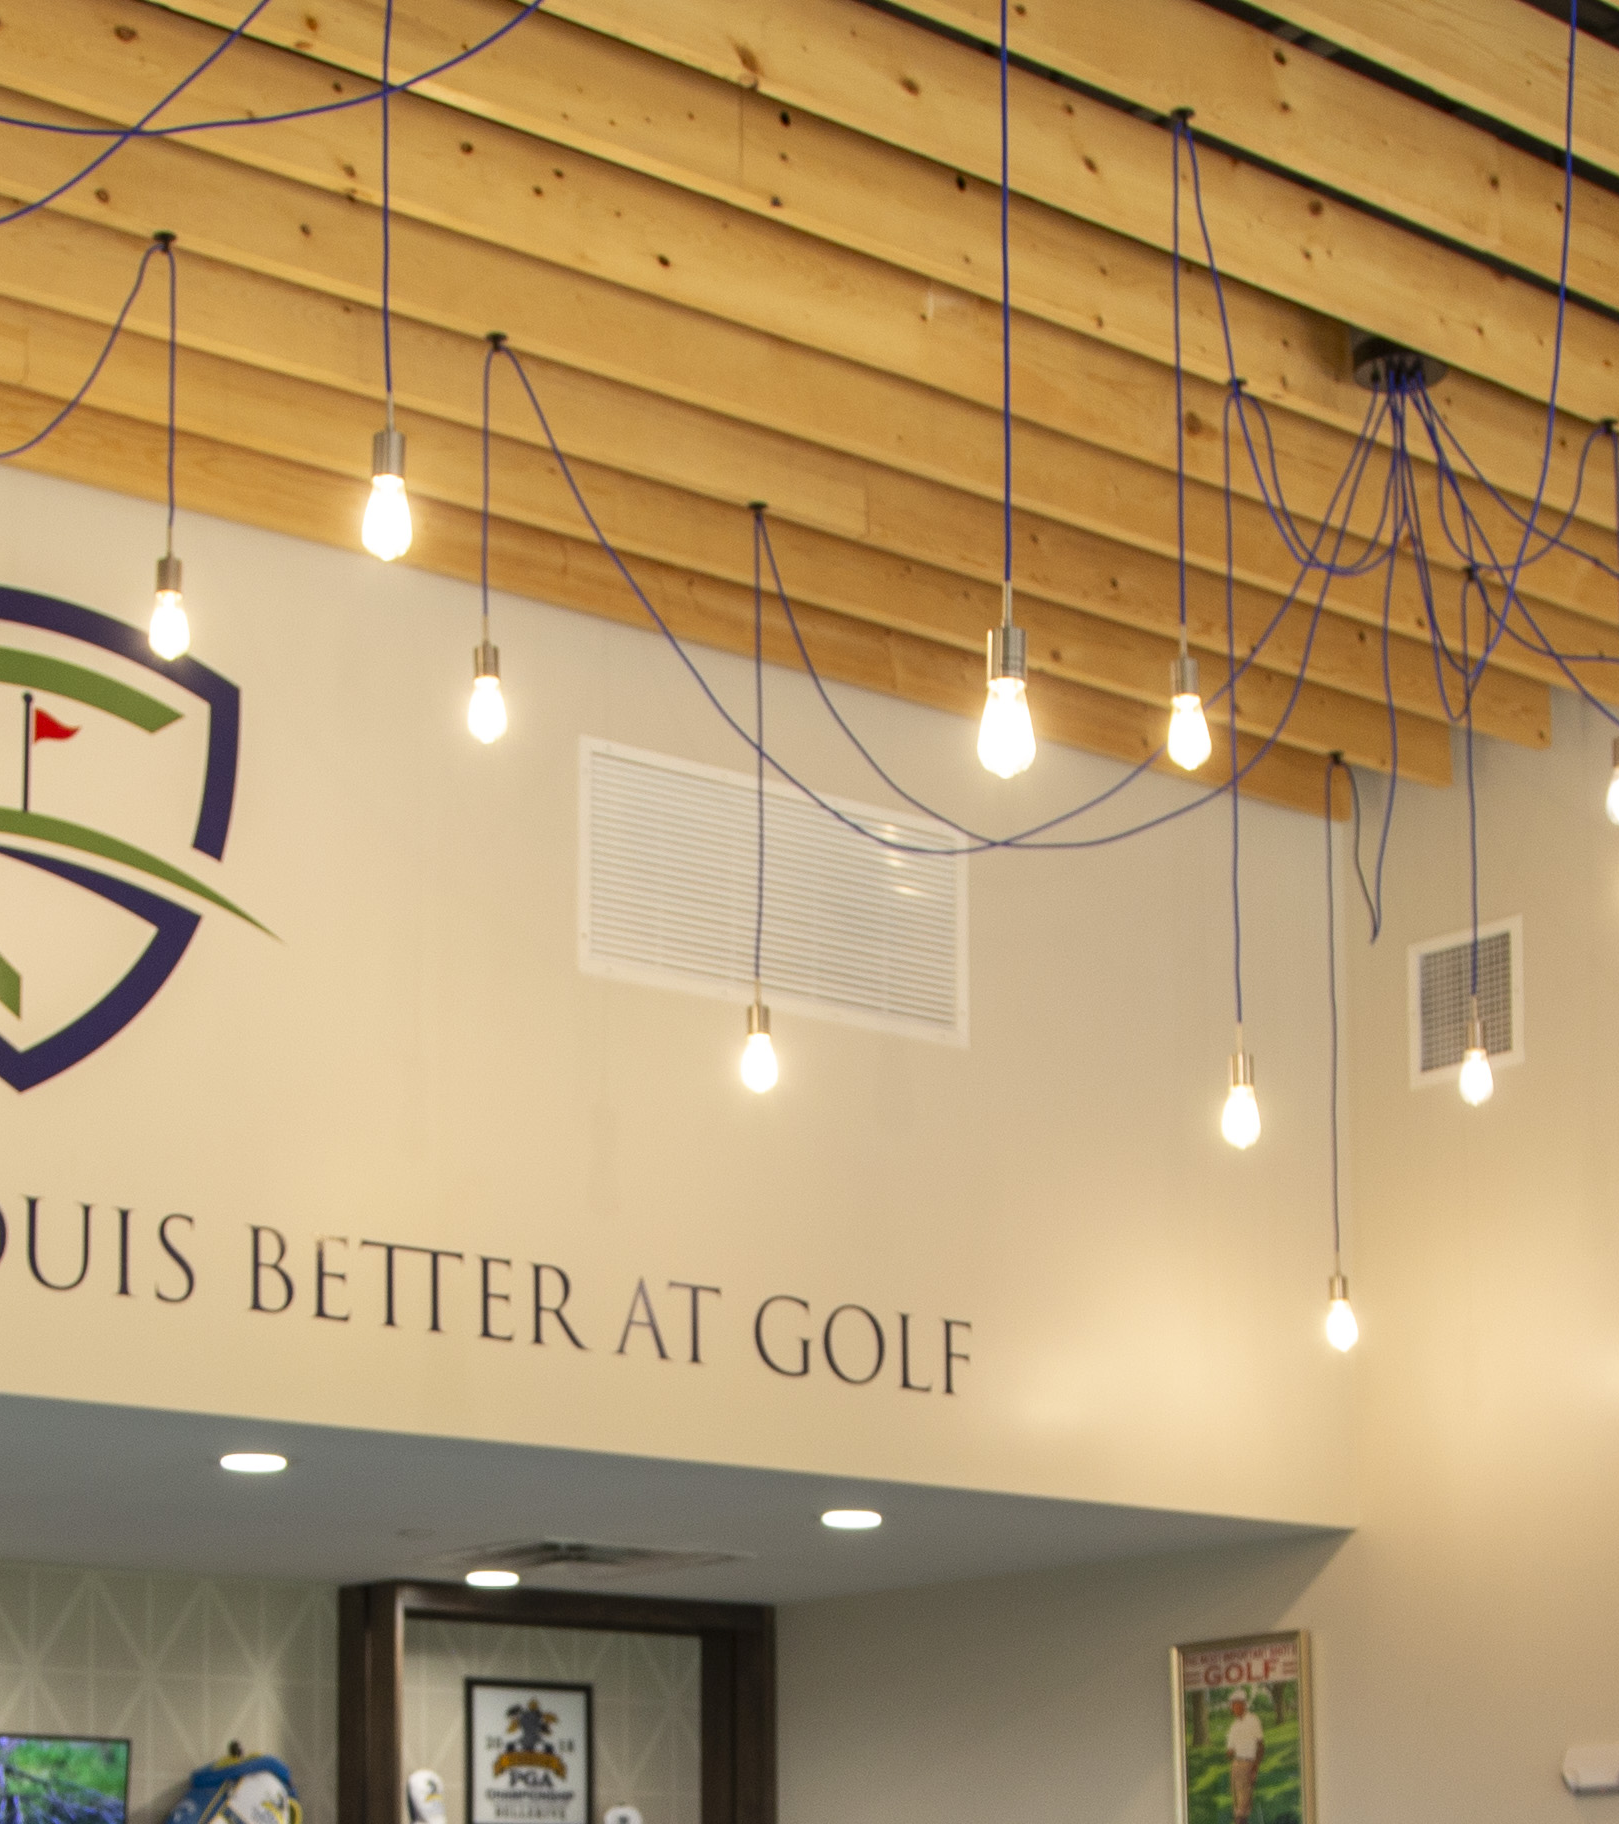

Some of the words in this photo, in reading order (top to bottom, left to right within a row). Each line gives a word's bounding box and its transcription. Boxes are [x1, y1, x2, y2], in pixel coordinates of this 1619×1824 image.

[245, 1221, 591, 1352] BETTER
[615, 1275, 723, 1365] AT
[753, 1293, 974, 1397] GOLF
[1204, 1659, 1278, 1686] GOLF
